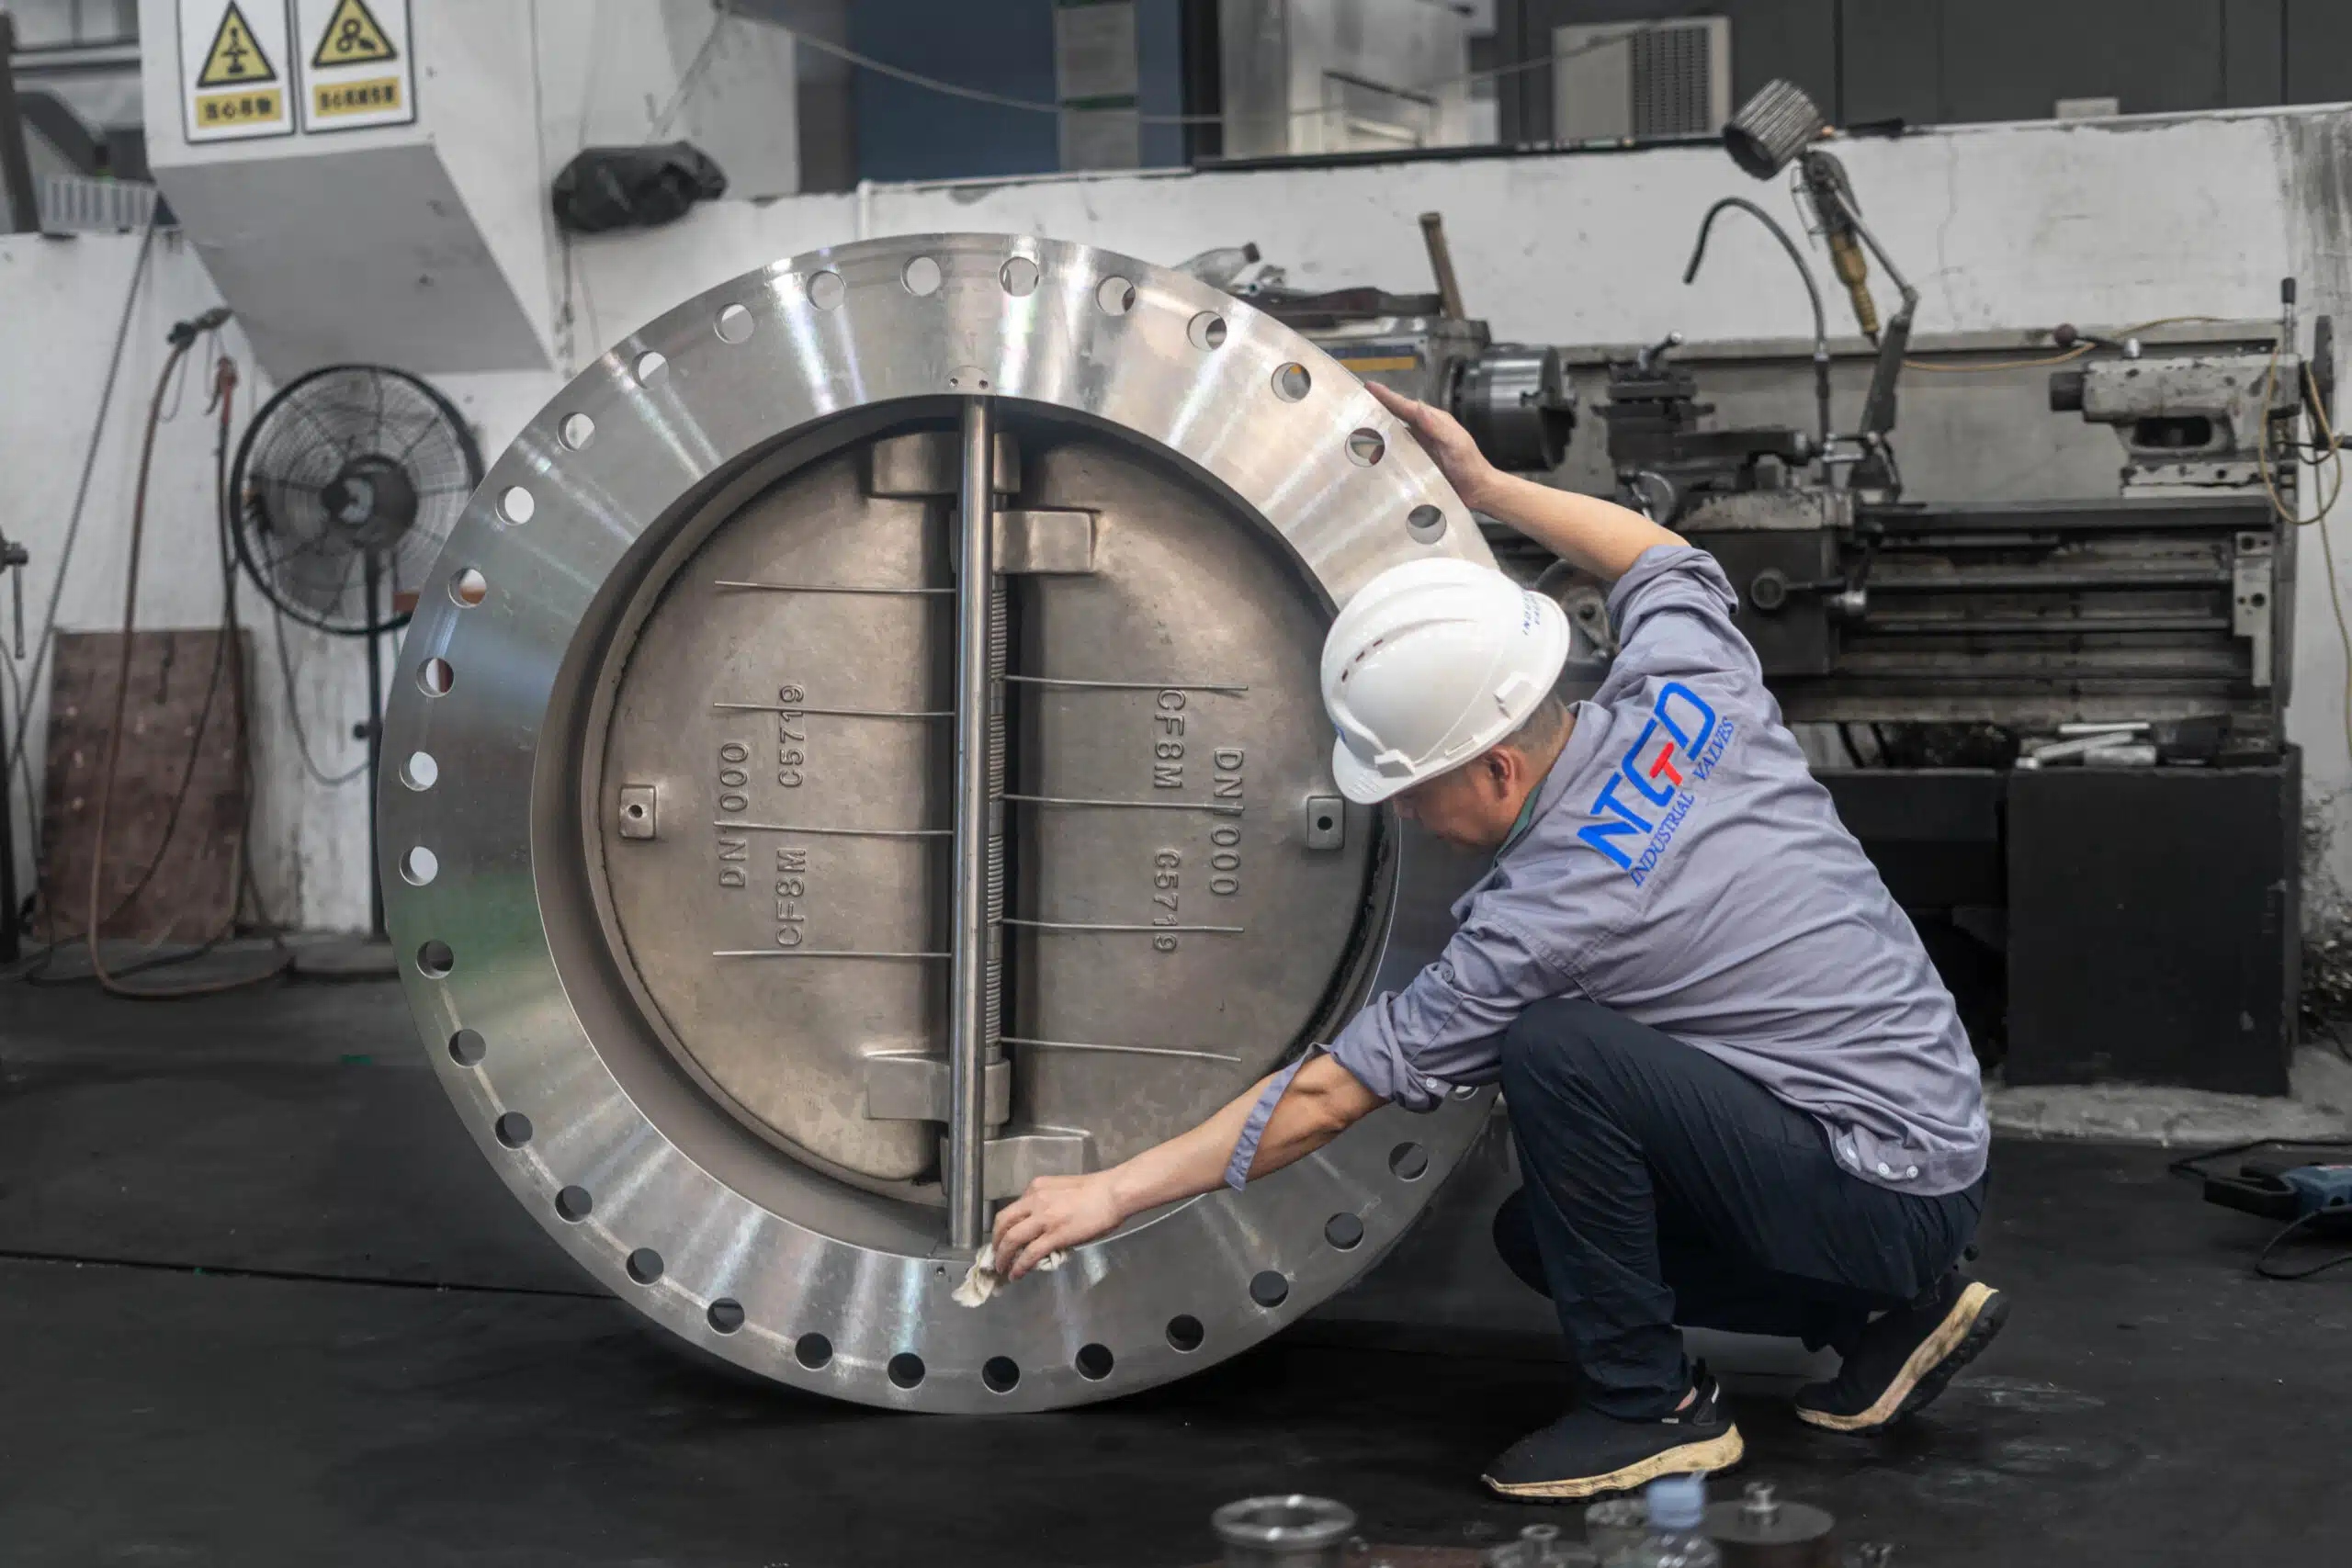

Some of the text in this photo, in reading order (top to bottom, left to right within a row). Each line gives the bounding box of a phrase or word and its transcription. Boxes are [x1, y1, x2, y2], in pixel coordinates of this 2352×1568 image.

[775, 683, 807, 947] CF8M C5719
[1154, 688, 1186, 789] CF8M
[1628, 715, 1736, 888] INDUSTRIAL VALVES
[1210, 748, 1244, 897] DN1000
